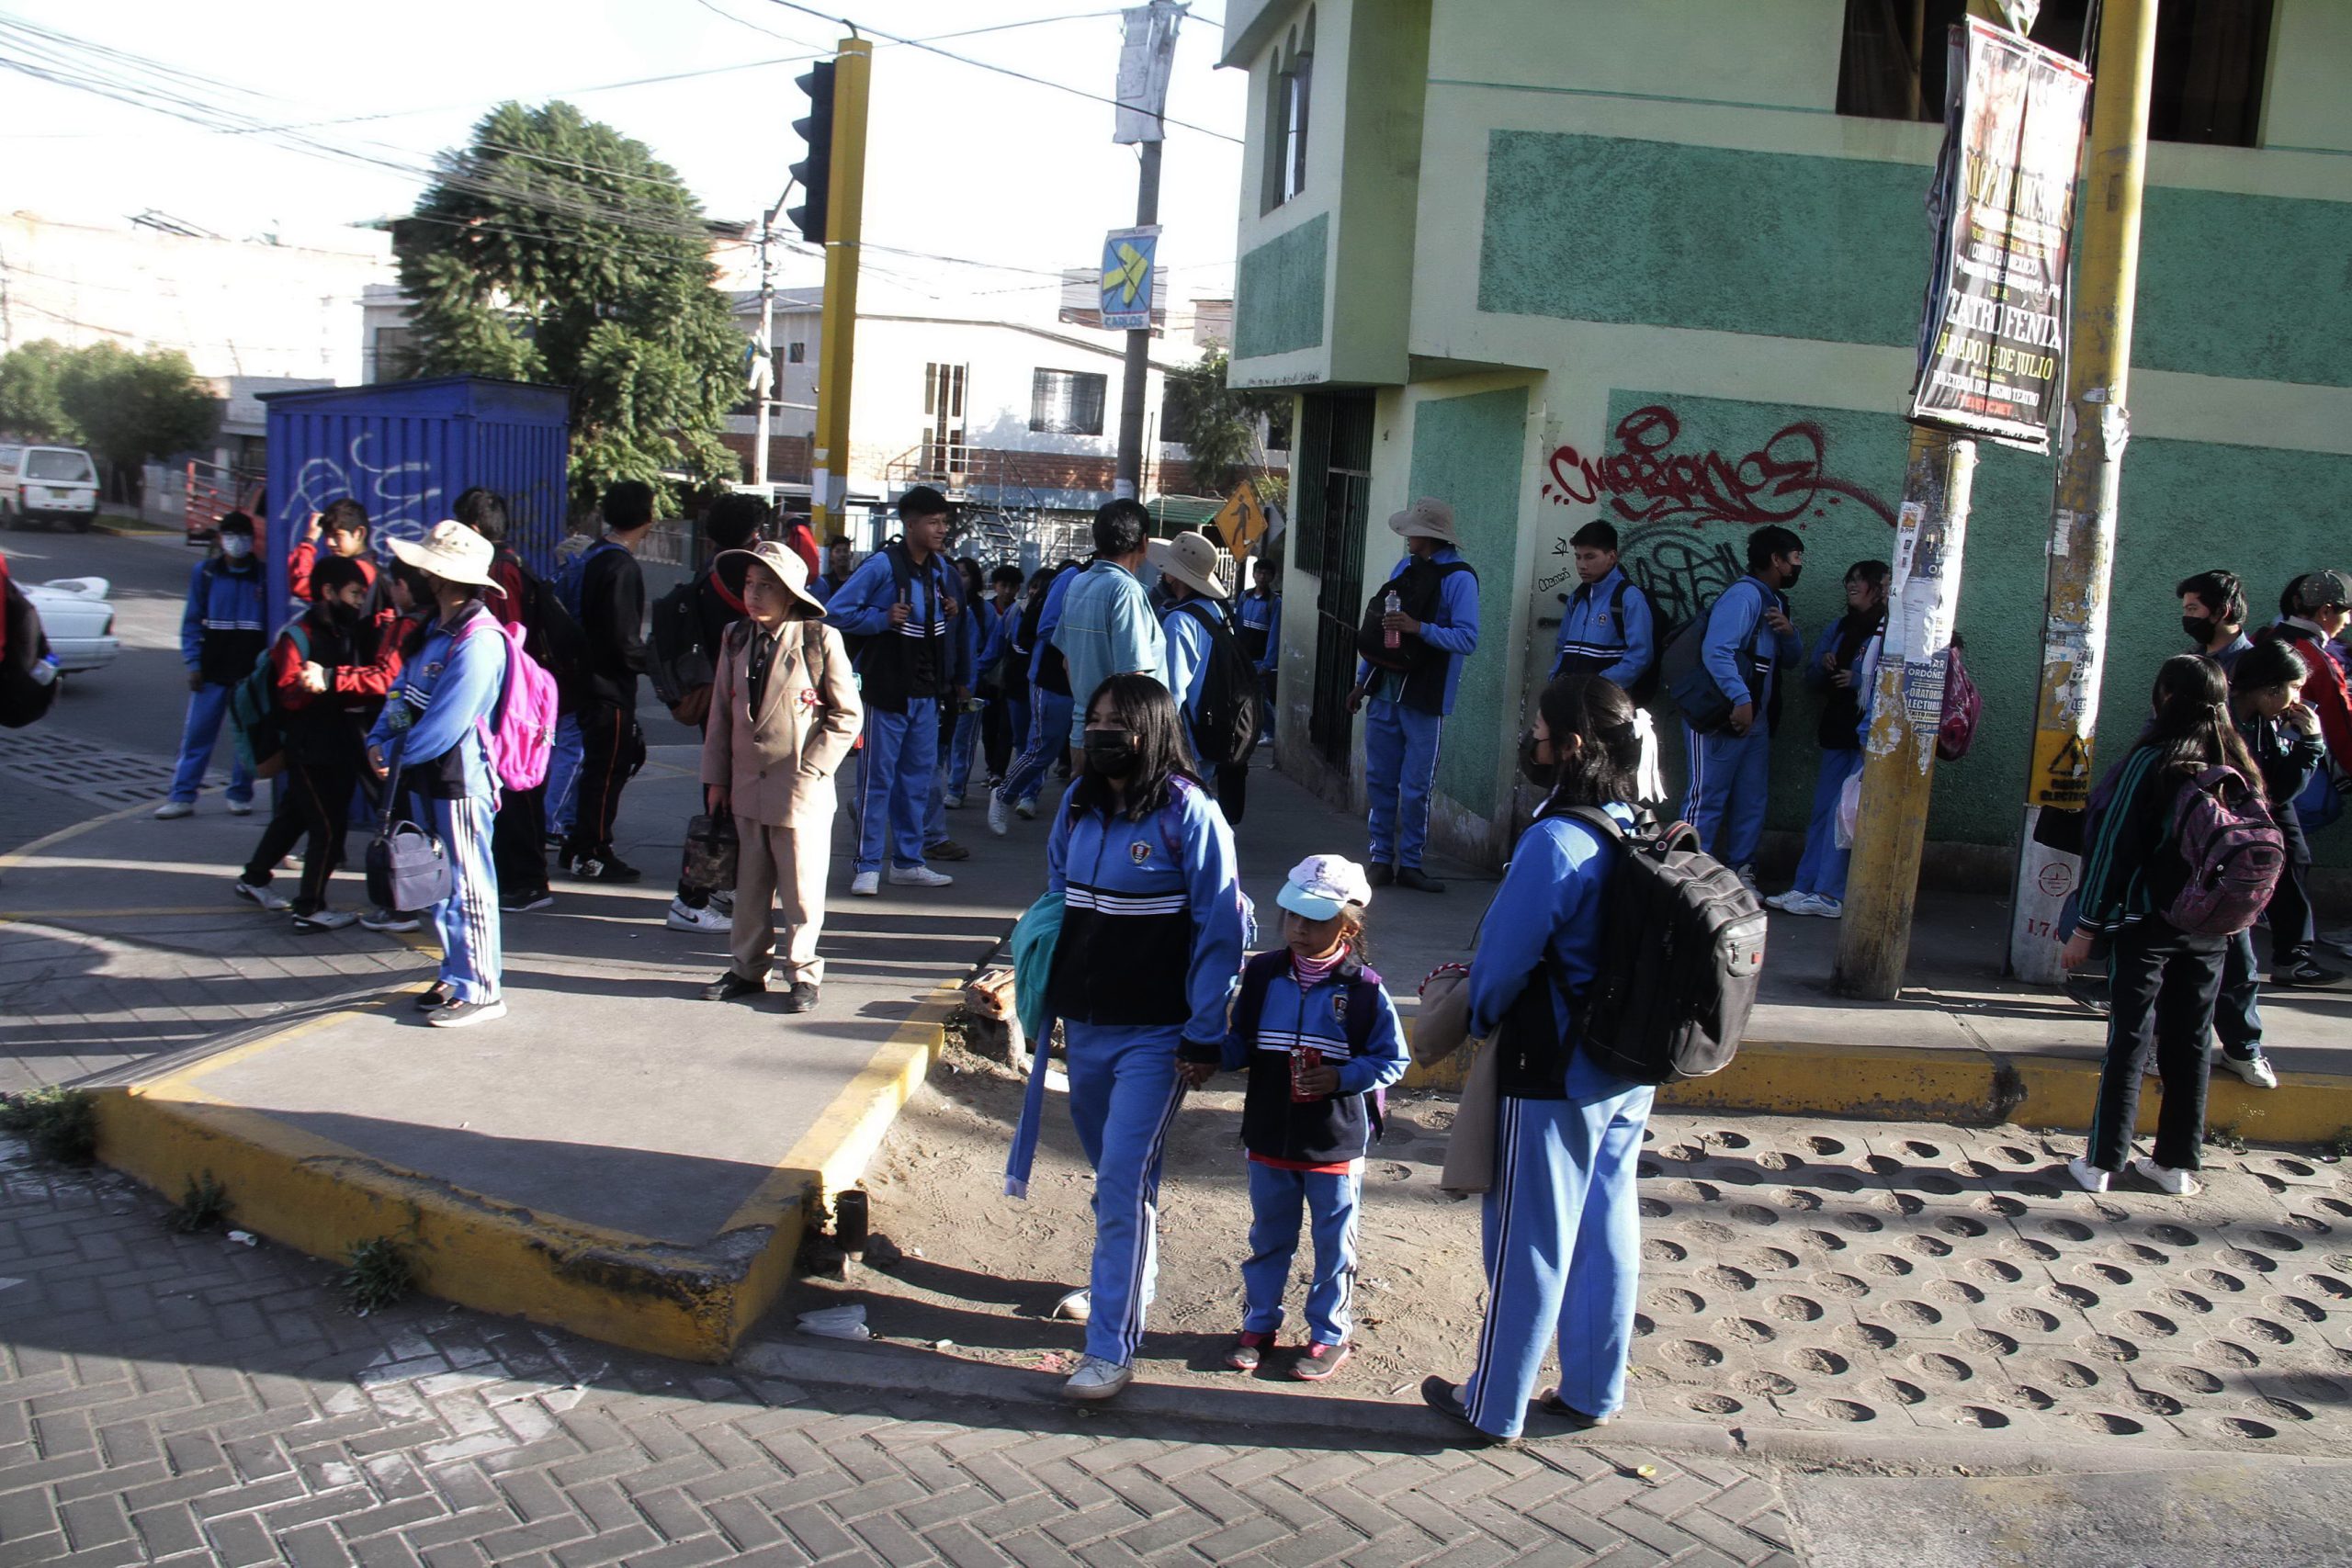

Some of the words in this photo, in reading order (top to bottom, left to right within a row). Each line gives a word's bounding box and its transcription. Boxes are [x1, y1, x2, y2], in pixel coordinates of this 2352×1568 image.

[1972, 243, 1995, 263] COMO
[1996, 249, 2008, 266] EN
[1104, 315, 1144, 327] CARLOS
[1946, 288, 2004, 335] TEATRO
[2003, 299, 2062, 354] FÉNIX
[1936, 325, 1983, 364] ÁBADO
[1997, 346, 2016, 372] DE
[2015, 351, 2053, 380] JULIO
[2012, 387, 2040, 406] TEATRO
[1907, 667, 1945, 680] ORDÓÑEZ
